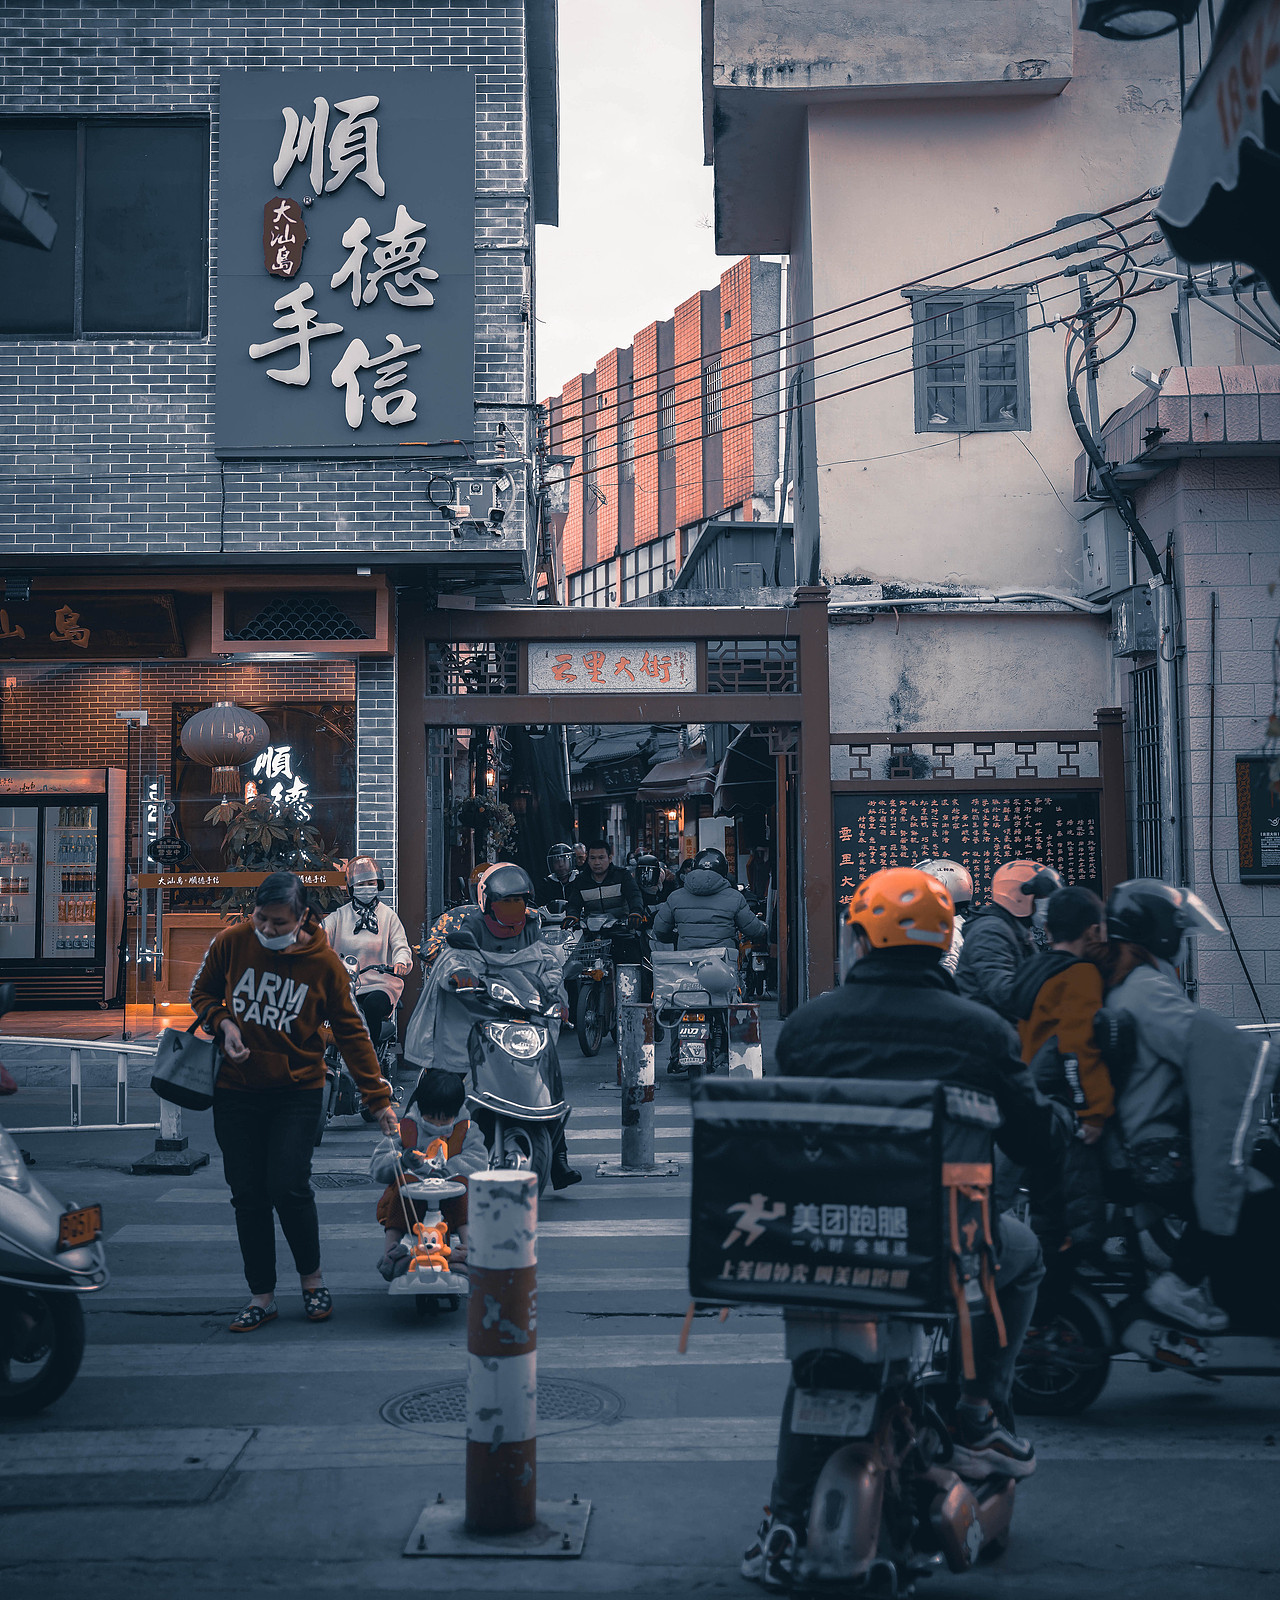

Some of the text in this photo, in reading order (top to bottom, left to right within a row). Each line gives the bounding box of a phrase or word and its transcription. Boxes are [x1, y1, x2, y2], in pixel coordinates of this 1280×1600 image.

[551, 650, 672, 684] 云里大街
[232, 967, 309, 1015] ARM
[232, 997, 298, 1034] PARK
[792, 1203, 909, 1238] 美团跑腿
